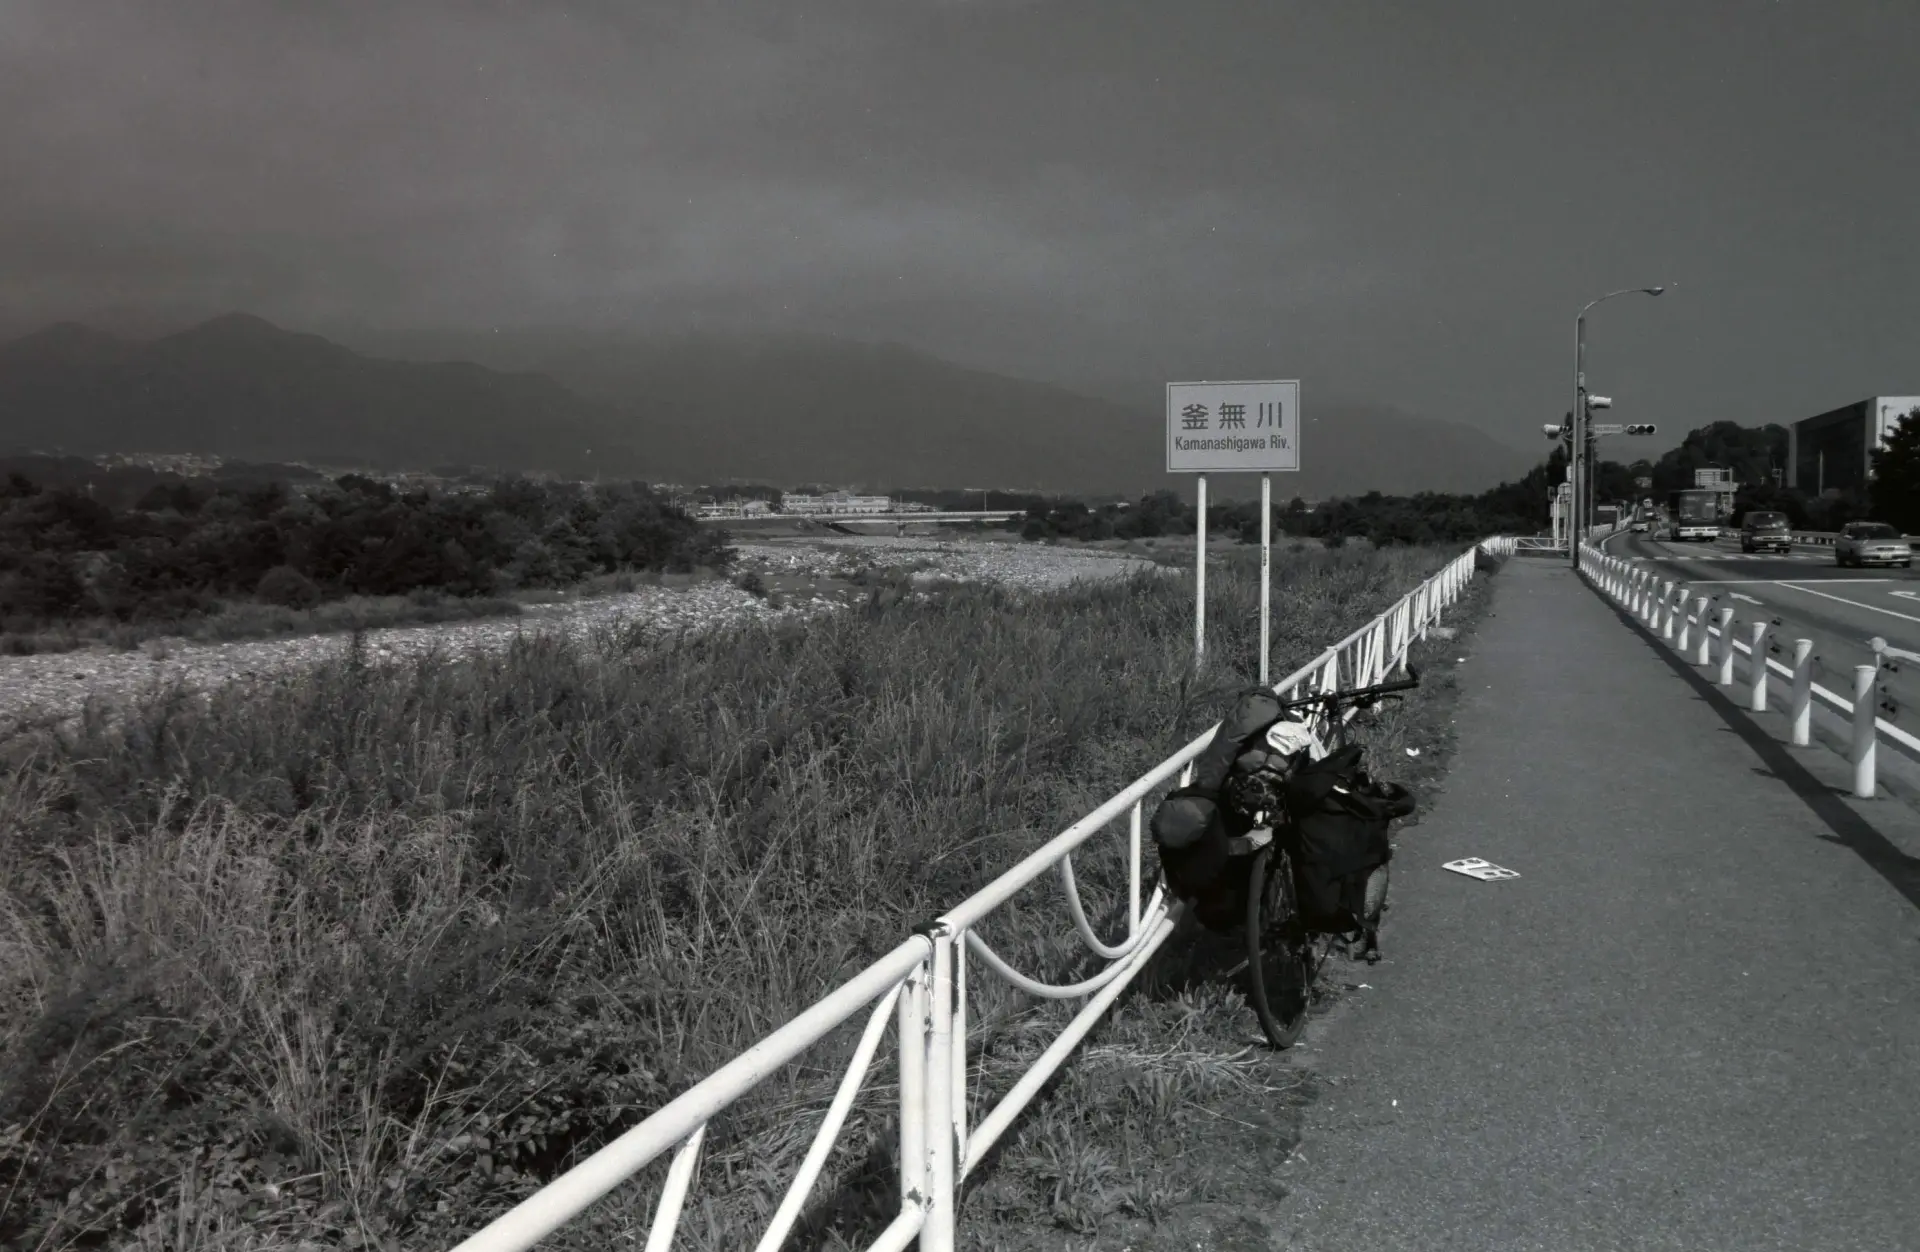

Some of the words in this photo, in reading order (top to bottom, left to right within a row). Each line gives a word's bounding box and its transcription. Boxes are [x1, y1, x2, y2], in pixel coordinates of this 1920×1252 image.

[1181, 402, 1283, 430] 釜無川
[1175, 436, 1266, 453] Kamanashigawa
[1270, 435, 1290, 450] Riv.
